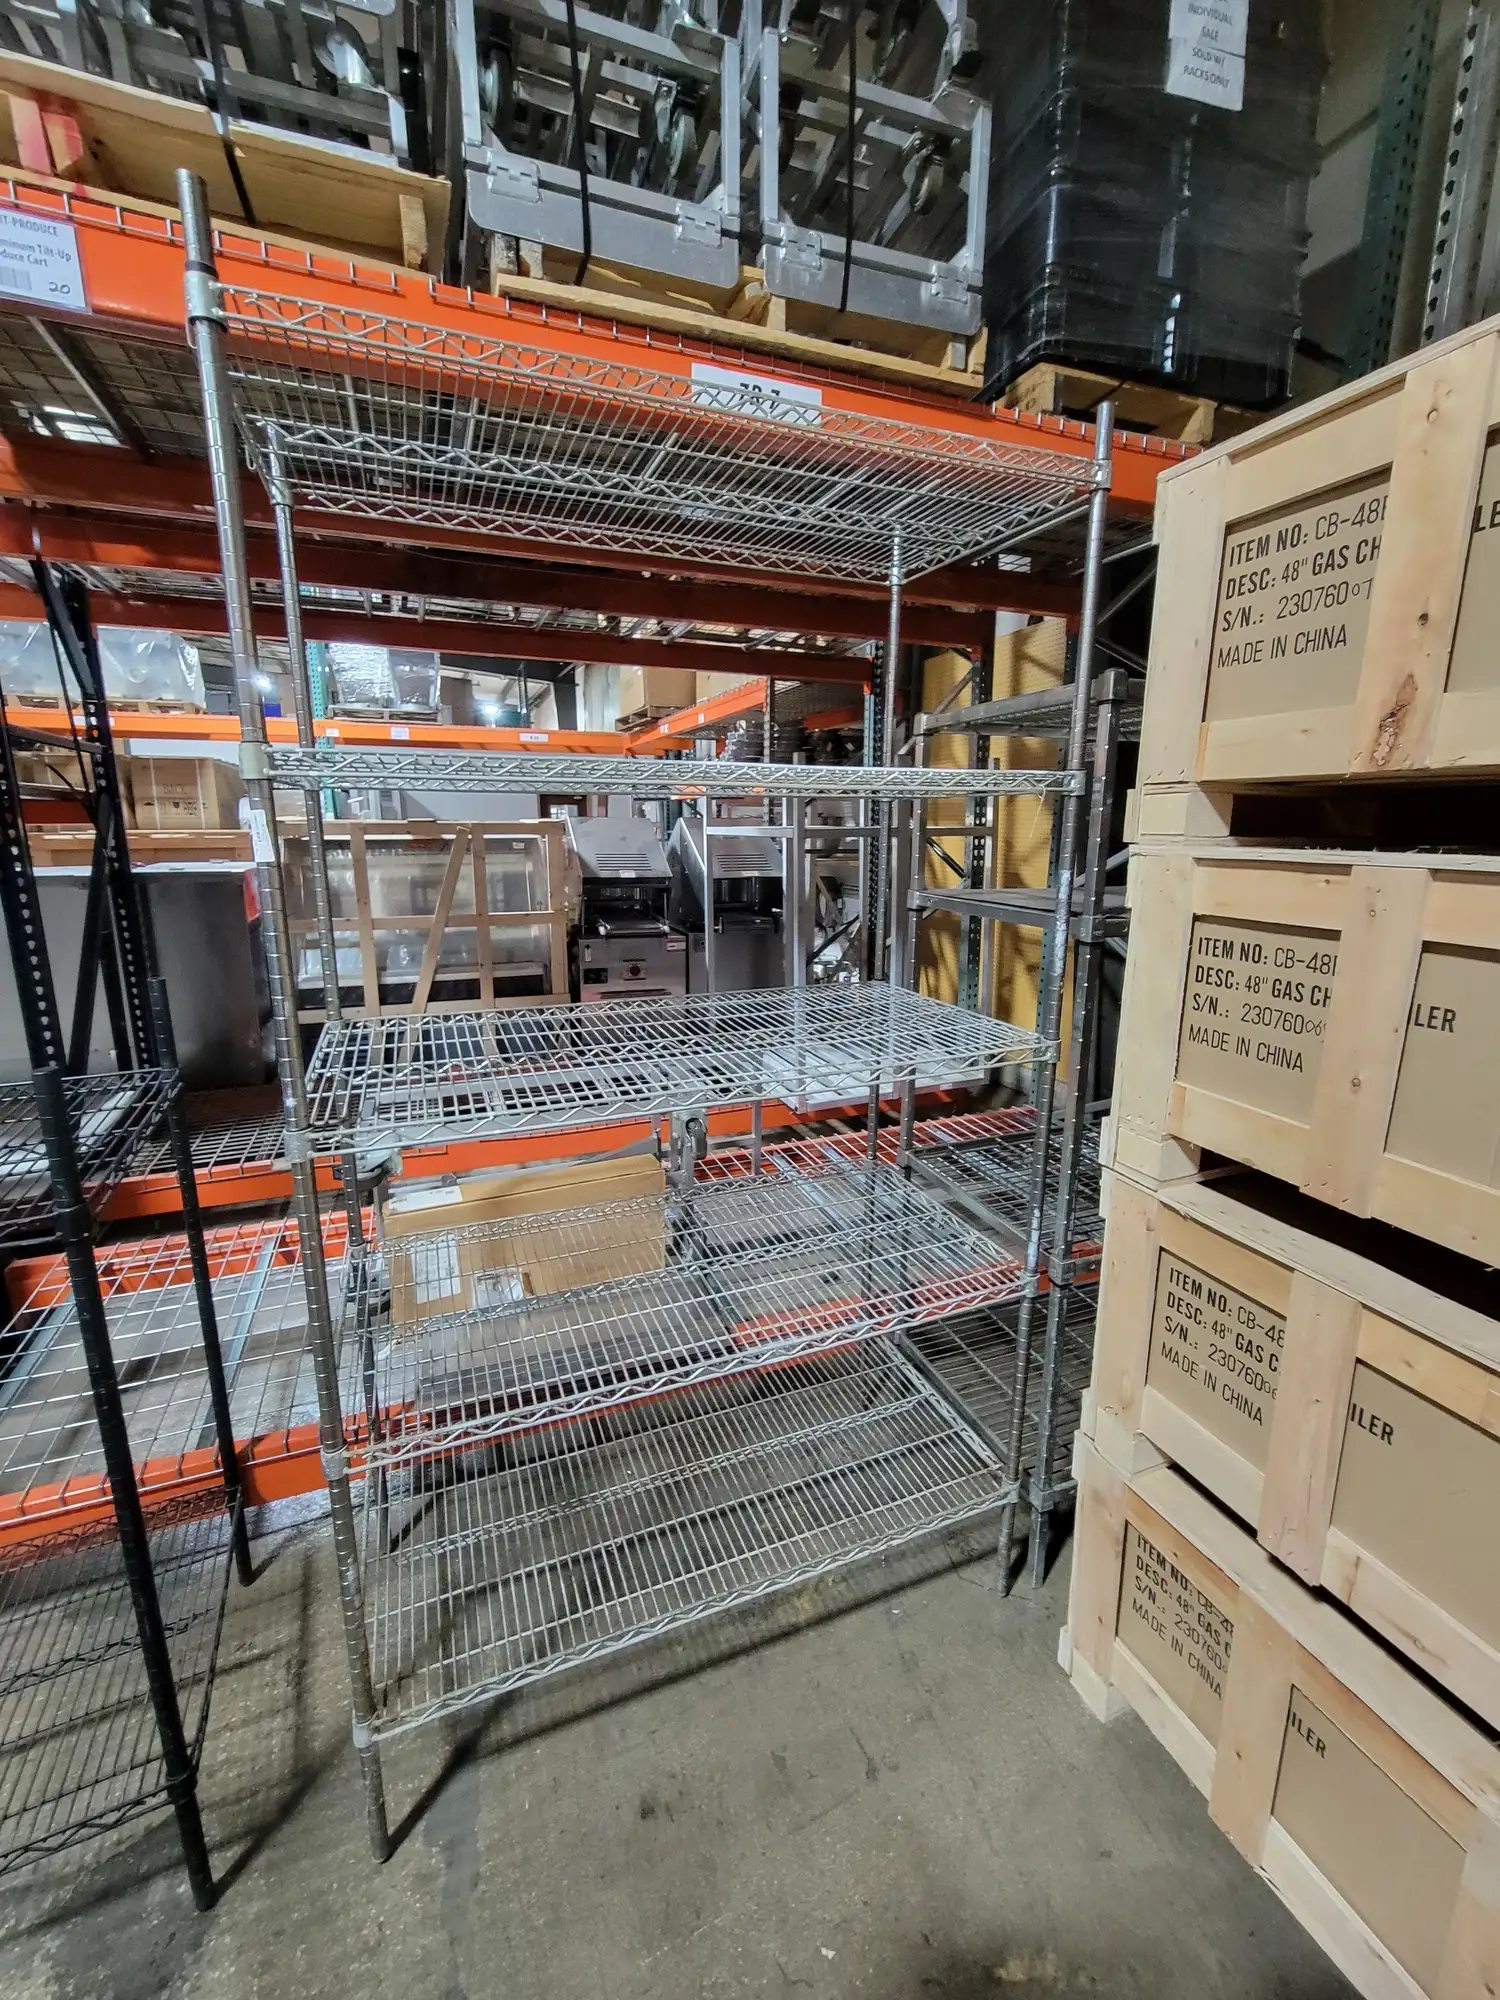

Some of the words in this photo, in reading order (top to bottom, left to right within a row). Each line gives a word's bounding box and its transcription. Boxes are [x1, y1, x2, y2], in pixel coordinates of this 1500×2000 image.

[1188, 3, 1233, 26] INDIVIDUAL
[1201, 26, 1219, 41] SALE
[1192, 47, 1212, 61] SOLD
[1183, 64, 1209, 81] RACKS
[1209, 73, 1231, 89] ONLY
[27, 254, 48, 268] Cart
[36, 243, 72, 263] Tilt-Up
[48, 281, 71, 295] 20
[1229, 533, 1271, 568] ITEM
[1276, 523, 1309, 553] NO:
[1225, 567, 1276, 600] DESC:
[1281, 557, 1309, 584] 48"
[1312, 545, 1350, 576] GAS
[1355, 534, 1382, 565] CH
[1222, 605, 1264, 632] S/N.:
[1217, 639, 1265, 668] MADE
[1270, 634, 1288, 659] IN
[1294, 623, 1347, 655] CHINA
[1197, 937, 1235, 960] ITEM
[1239, 942, 1268, 965] NO:
[1195, 965, 1240, 991] DESC:
[1244, 975, 1268, 994] 48"
[1272, 978, 1305, 1003] GAS
[1192, 993, 1229, 1018] S/N.:
[1241, 1003, 1327, 1039] 23076006
[1414, 1003, 1457, 1033] LER
[1188, 1024, 1231, 1052] MADE
[1235, 1035, 1251, 1058] IN
[1256, 1042, 1303, 1073] CHINA
[1169, 1267, 1203, 1300] ITEM
[1206, 1287, 1233, 1317] NO:
[1164, 1315, 1199, 1350] S/N.:
[1166, 1291, 1208, 1329] DESC:
[1211, 1320, 1233, 1340] 48"
[1235, 1332, 1265, 1363] GAS
[1268, 1353, 1280, 1374] C
[1161, 1341, 1199, 1380] MADE
[1203, 1370, 1217, 1392] IN
[1221, 1383, 1263, 1426] CHINA
[1350, 1402, 1394, 1446] ILER
[1137, 1535, 1166, 1572] ITEM
[1170, 1563, 1193, 1597] NO:
[1134, 1575, 1166, 1615] S/N.:
[1136, 1554, 1172, 1599] DESC:
[1176, 1594, 1195, 1614] 48"
[1198, 1612, 1221, 1646] GAS
[1132, 1597, 1167, 1641] MADE
[1171, 1634, 1184, 1657] IN
[1187, 1651, 1222, 1701] CHINA
[1291, 1711, 1326, 1759] ILER
